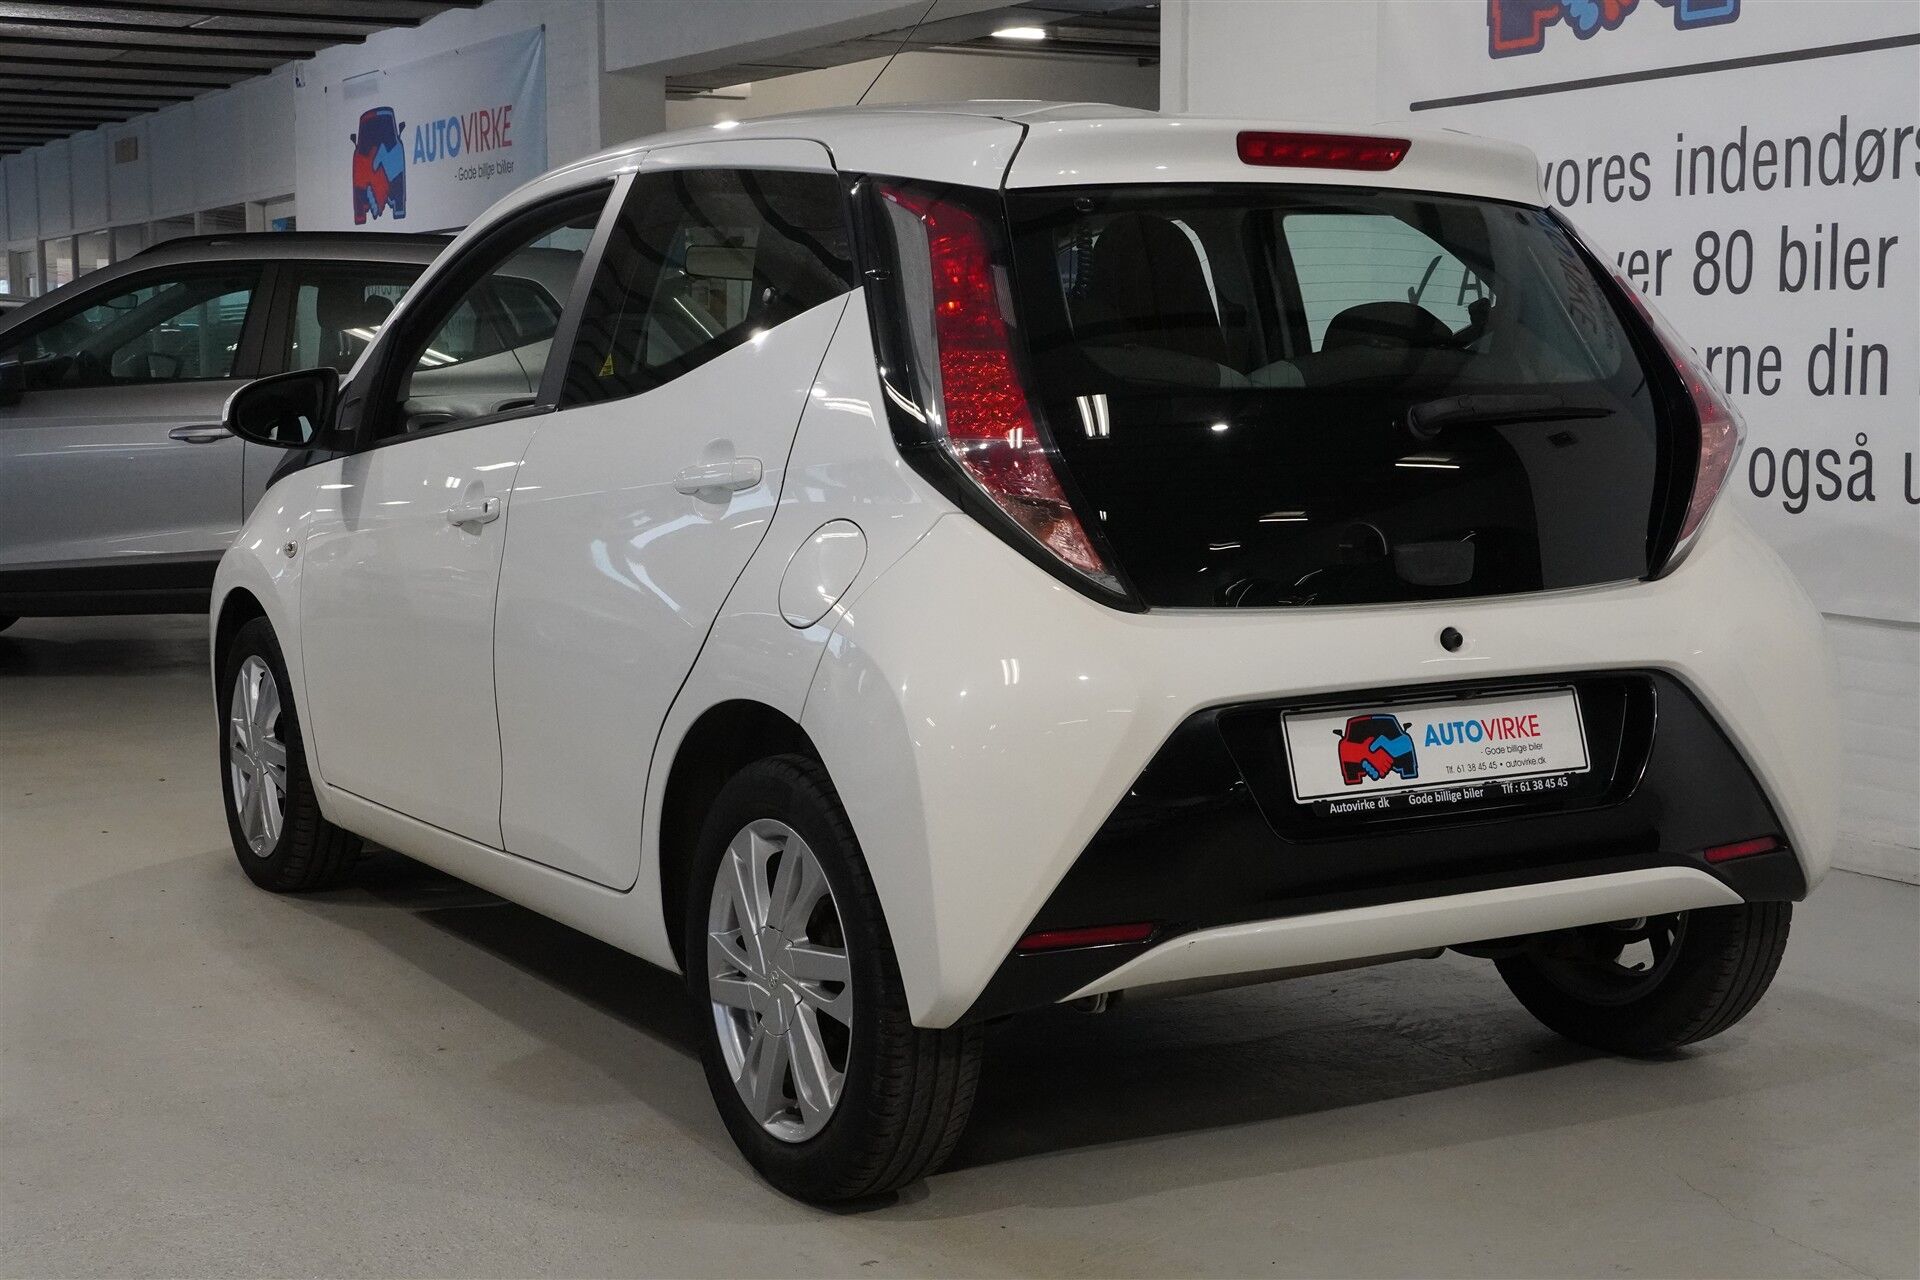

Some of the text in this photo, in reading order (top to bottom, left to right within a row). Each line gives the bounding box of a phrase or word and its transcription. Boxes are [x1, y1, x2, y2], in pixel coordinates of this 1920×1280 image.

[413, 105, 512, 164] AUTOVIRKE
[458, 166, 477, 181] Gode
[1693, 229, 1753, 296] 80
[1779, 223, 1899, 293] biler
[1808, 328, 1888, 396] din
[1748, 432, 1876, 514] også
[1425, 715, 1541, 747] AUTOVIRKE
[1485, 745, 1506, 756] Gode
[1506, 744, 1527, 754] billige
[1528, 742, 1543, 751] biler
[1457, 764, 1465, 773] 61
[1467, 763, 1477, 772] 38
[1478, 761, 1487, 771] 45
[1489, 760, 1498, 770] 45
[1329, 798, 1376, 814] Autovirke
[1378, 796, 1390, 808] dk
[1408, 792, 1433, 805] Gode
[1435, 787, 1462, 803] billige
[1463, 787, 1484, 799] biler
[1520, 781, 1532, 792] 61
[1532, 779, 1543, 790] 38
[1545, 778, 1556, 789] 45
[1557, 776, 1569, 787] 45
